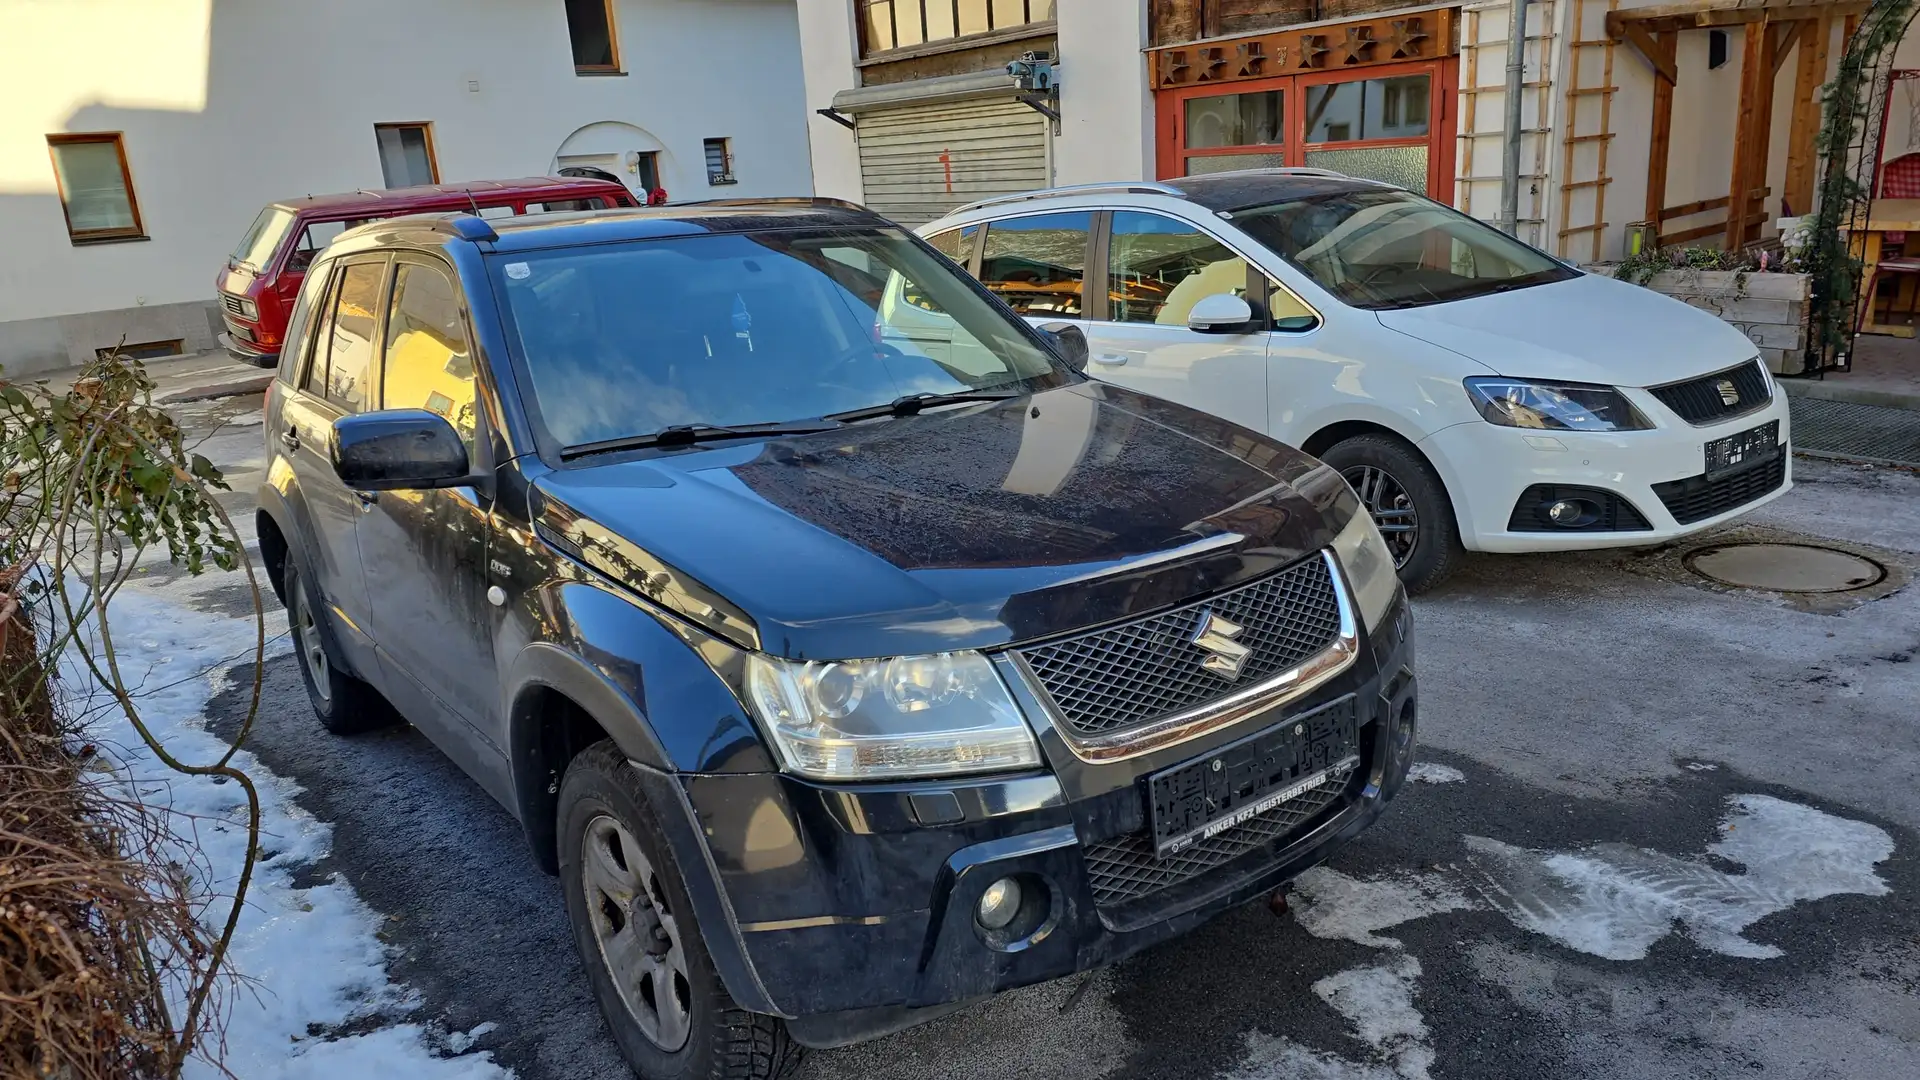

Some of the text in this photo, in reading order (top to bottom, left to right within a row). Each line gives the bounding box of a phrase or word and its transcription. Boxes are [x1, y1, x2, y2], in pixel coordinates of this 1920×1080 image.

[1203, 773, 1327, 839] ANKER KFZ MEISTERBETRIEB
